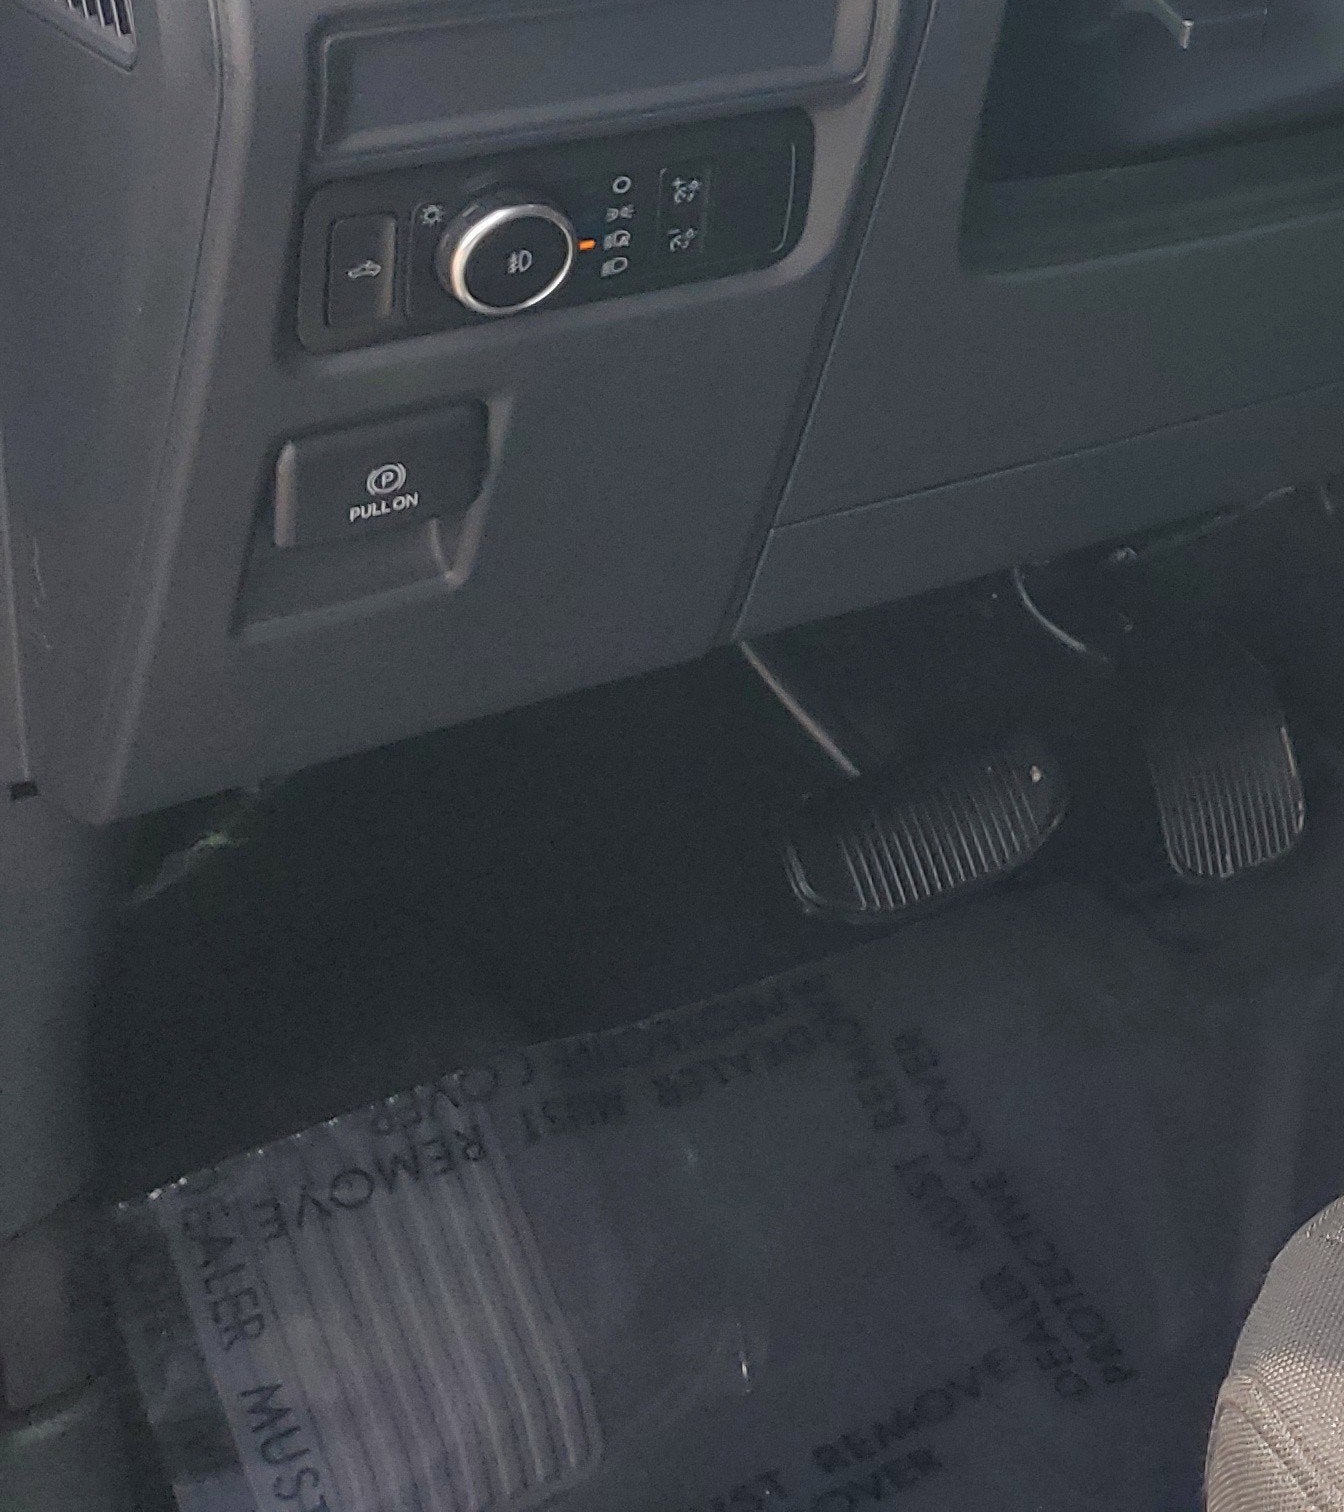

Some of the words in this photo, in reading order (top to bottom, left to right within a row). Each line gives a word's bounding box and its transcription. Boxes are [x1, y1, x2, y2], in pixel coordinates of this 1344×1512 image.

[349, 500, 391, 523] PULL
[392, 491, 419, 511] ON
[253, 1124, 488, 1244] REMOVE
[812, 1448, 944, 1512] OVER
